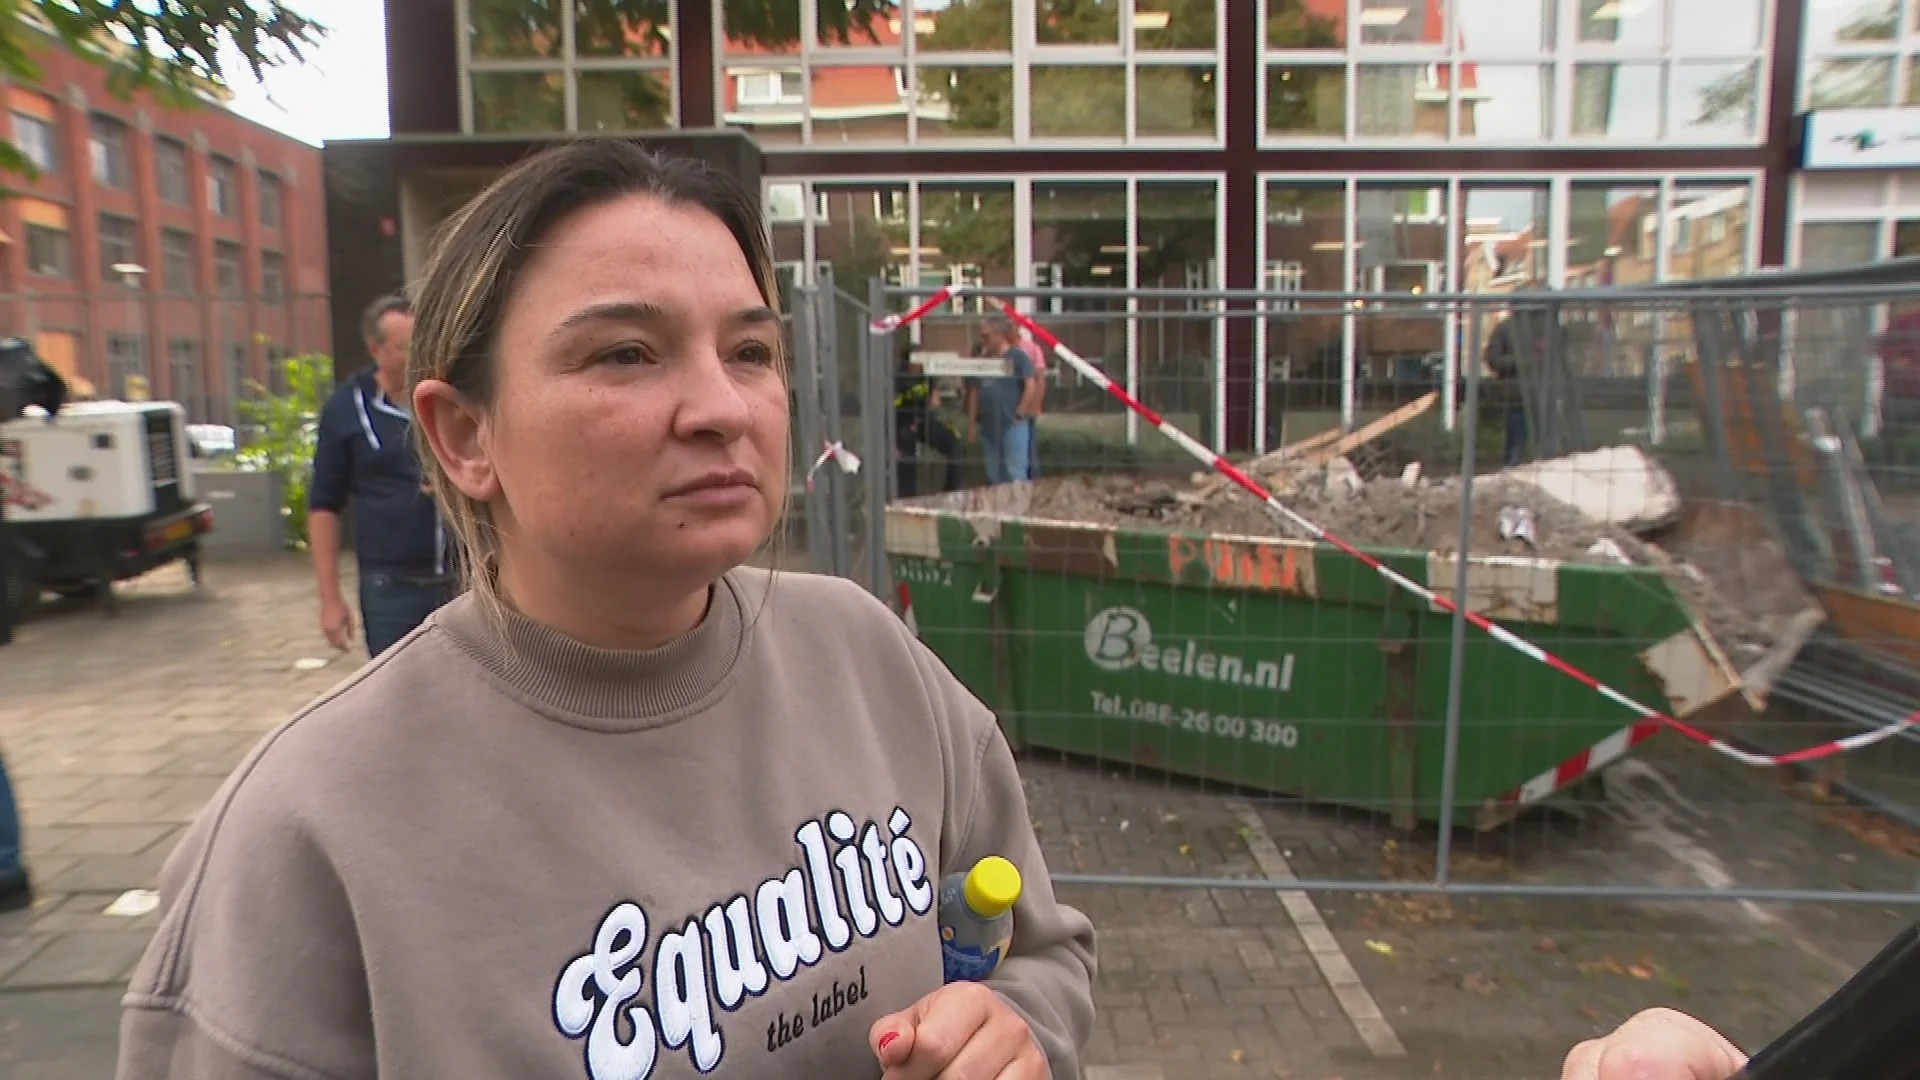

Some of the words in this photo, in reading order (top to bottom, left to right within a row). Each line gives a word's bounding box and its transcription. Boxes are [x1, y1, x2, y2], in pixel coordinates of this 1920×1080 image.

[1085, 606, 1295, 691] Beelen.nl
[1090, 691, 1127, 718] Tel.
[1214, 714, 1246, 739] 00
[1249, 718, 1298, 748] 300
[553, 806, 933, 1080] Equalité
[767, 1005, 804, 1052] the
[811, 965, 869, 1029] label
